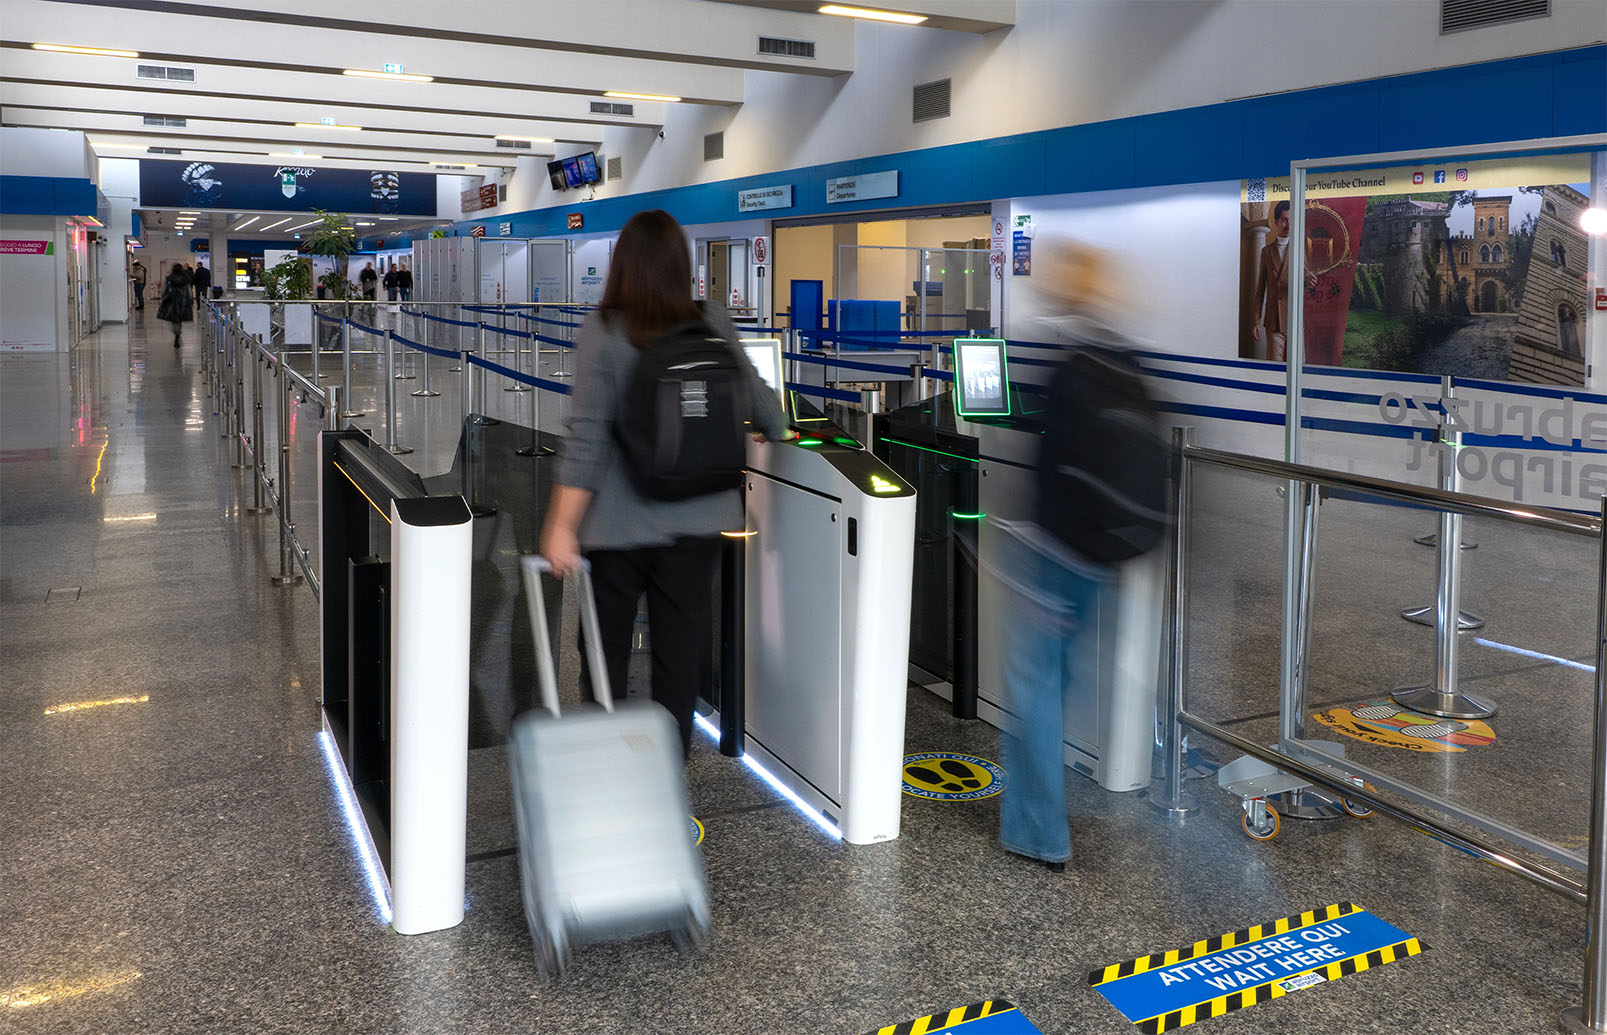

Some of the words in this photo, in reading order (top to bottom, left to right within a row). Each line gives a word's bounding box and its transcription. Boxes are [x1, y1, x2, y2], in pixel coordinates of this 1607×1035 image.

[1318, 181, 1351, 190] YouTube
[1352, 176, 1386, 188] Channel
[951, 754, 979, 764] QUI
[1158, 936, 1304, 987] ATTENDERE
[1300, 923, 1351, 943] QUI
[1204, 963, 1276, 991] WAIT
[1274, 943, 1346, 971] HERE
